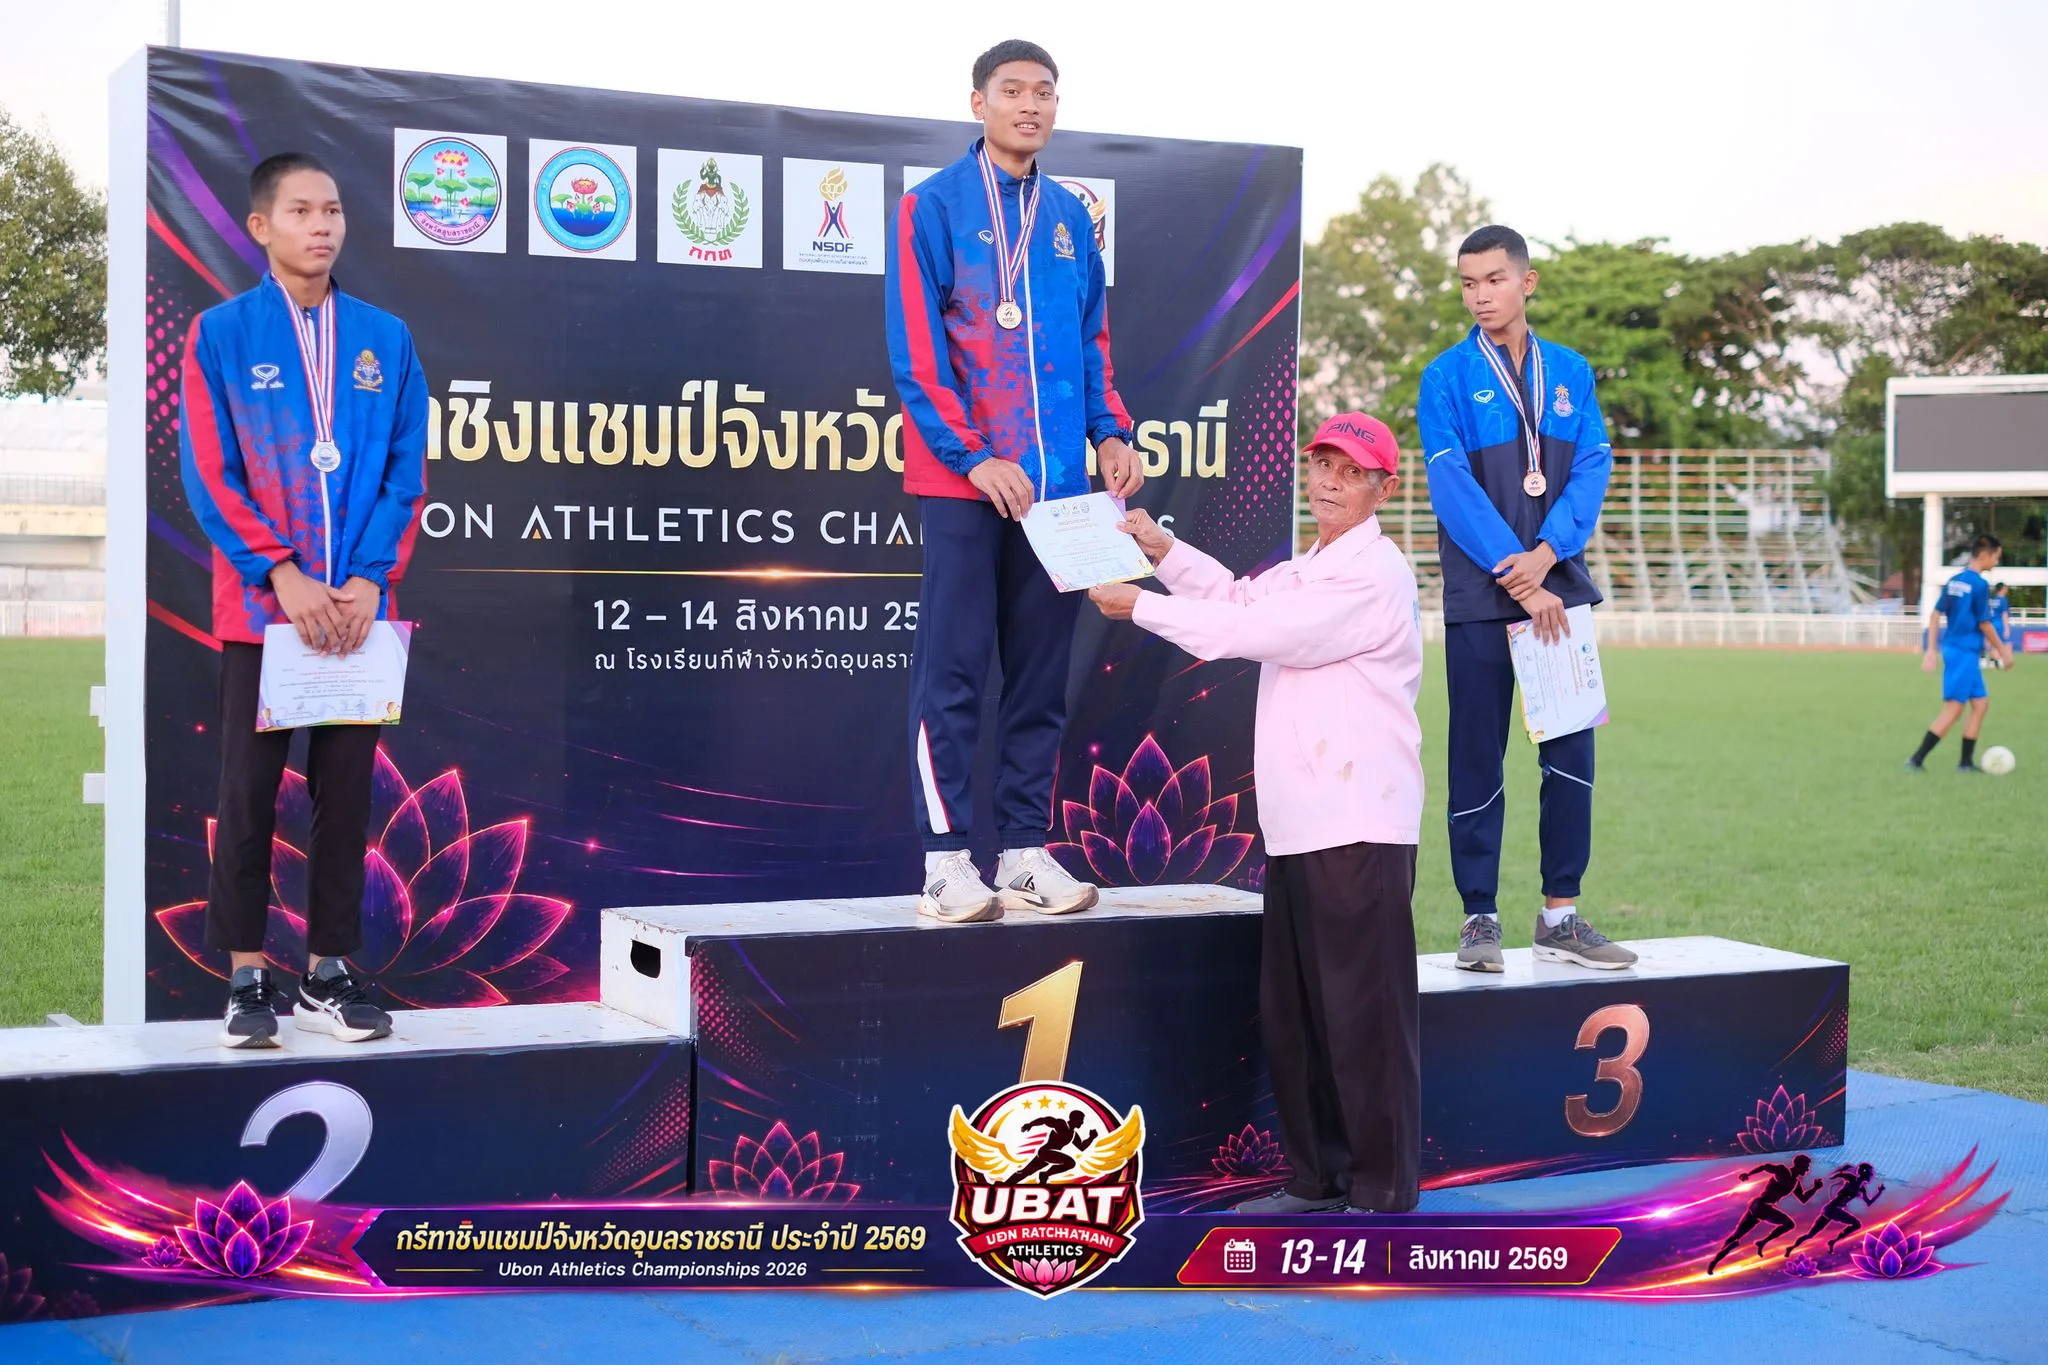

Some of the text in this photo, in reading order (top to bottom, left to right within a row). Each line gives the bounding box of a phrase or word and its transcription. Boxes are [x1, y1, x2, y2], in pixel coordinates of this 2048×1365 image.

[689, 246, 732, 261] กกท
[812, 241, 854, 253] NSDF
[1326, 422, 1376, 444] PING
[521, 504, 795, 544] ATHLETICS
[820, 510, 923, 545] CHA
[593, 600, 631, 631] 12
[681, 600, 718, 631] 14
[735, 598, 868, 631] สิงหาคม
[594, 647, 914, 676] ณ โรงเรียนกีฬาจังหวัดอุบลรา
[998, 961, 1083, 1083] 1
[1565, 1003, 1650, 1137] 3
[240, 1081, 373, 1204] 2
